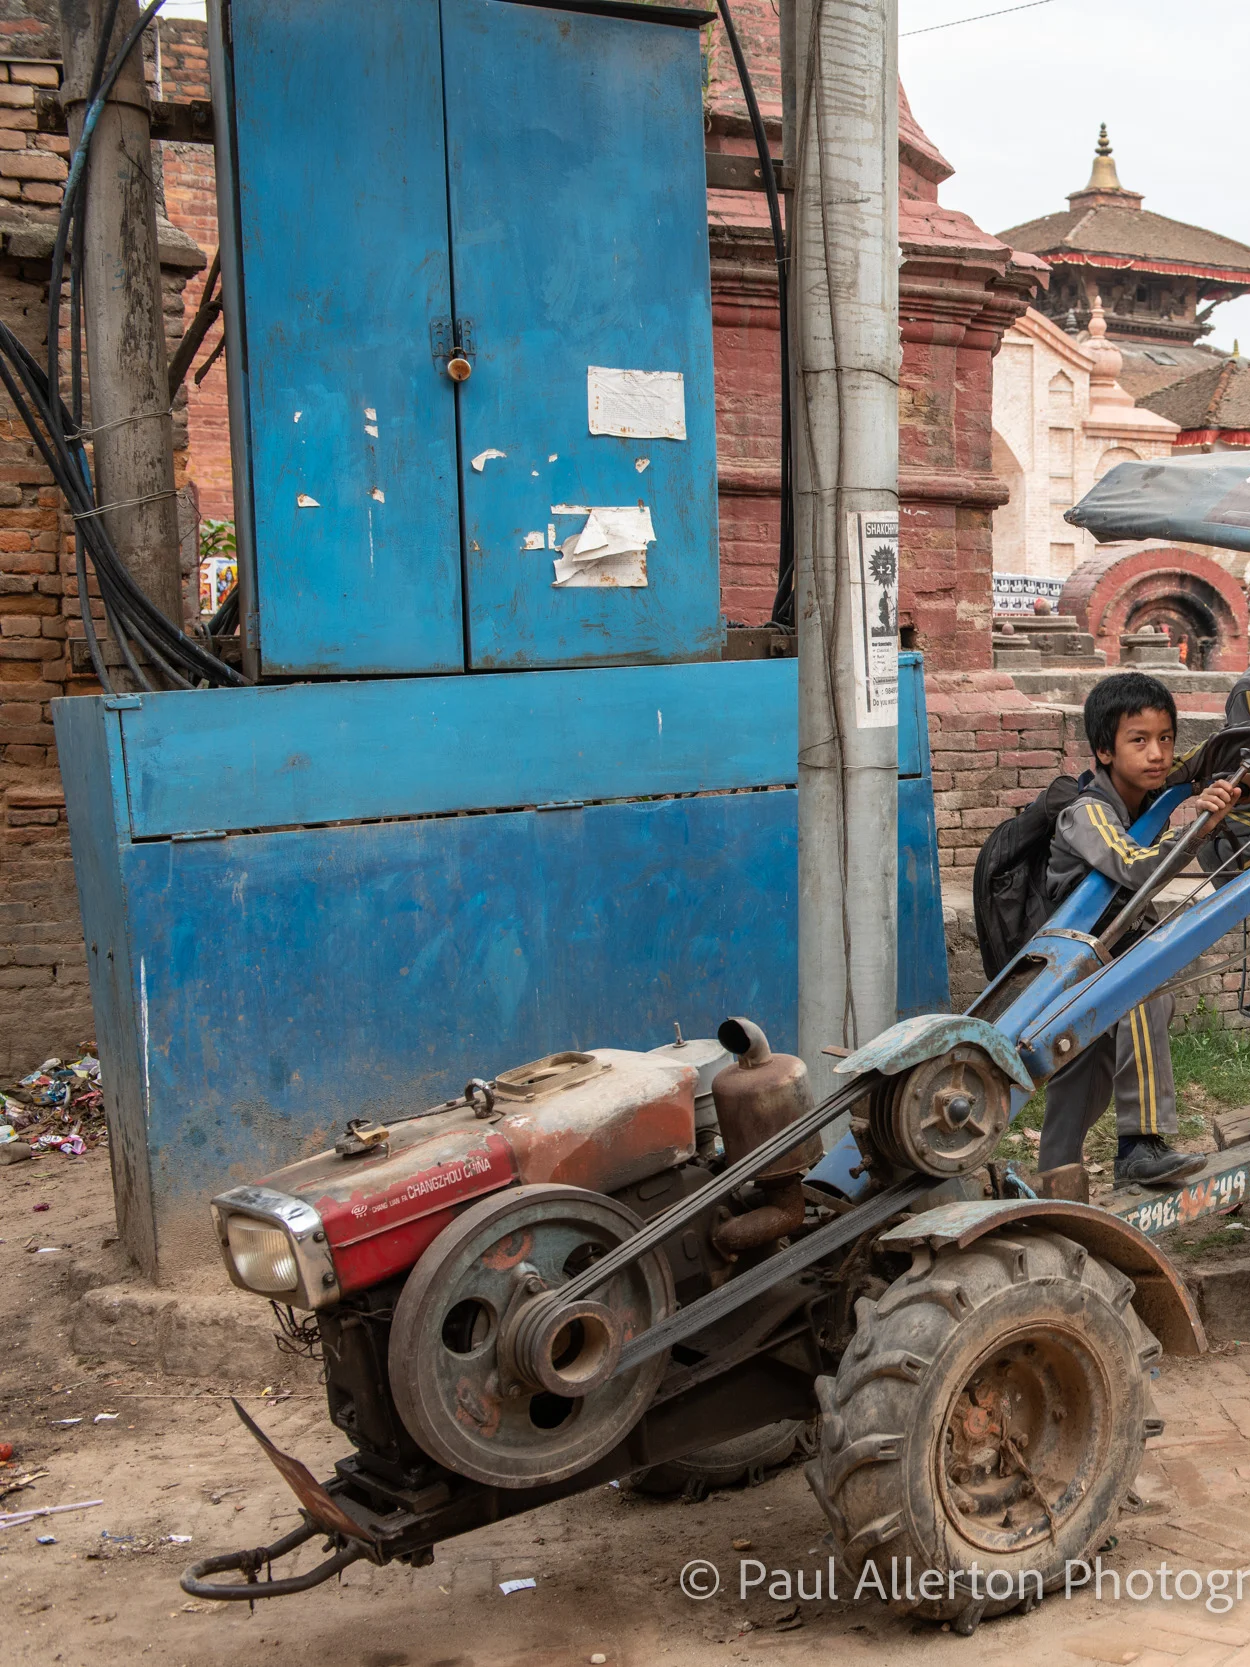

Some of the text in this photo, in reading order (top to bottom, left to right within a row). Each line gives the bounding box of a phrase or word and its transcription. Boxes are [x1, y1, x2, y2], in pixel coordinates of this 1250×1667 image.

[877, 564, 892, 574] +2
[407, 1168, 462, 1199] CHANGZHOU
[463, 1158, 491, 1178] CHINA
